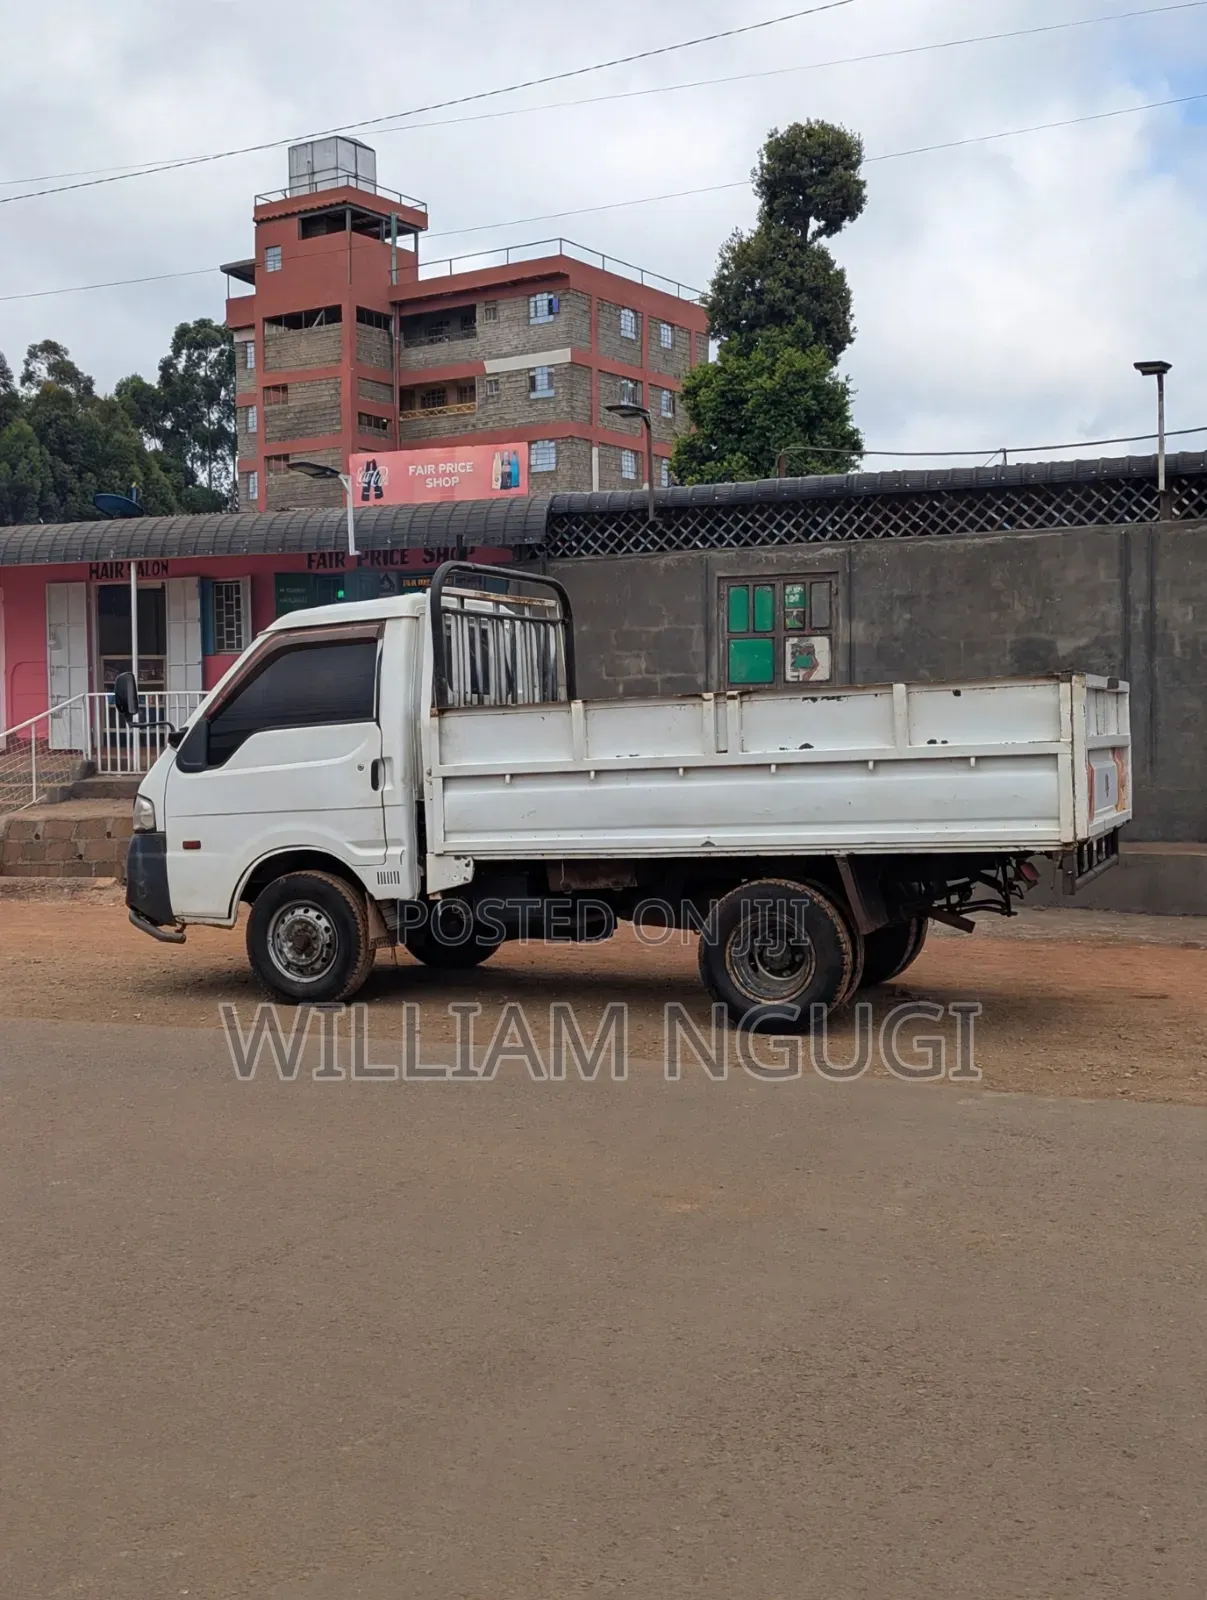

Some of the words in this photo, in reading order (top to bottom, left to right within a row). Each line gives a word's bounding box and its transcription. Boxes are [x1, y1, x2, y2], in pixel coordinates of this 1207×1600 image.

[408, 464, 436, 476] FAIR
[438, 461, 474, 474] PRICE
[425, 476, 460, 489] SHOP
[307, 551, 346, 570] FAIR
[356, 547, 409, 567] PRICE
[89, 561, 124, 579] HAIR
